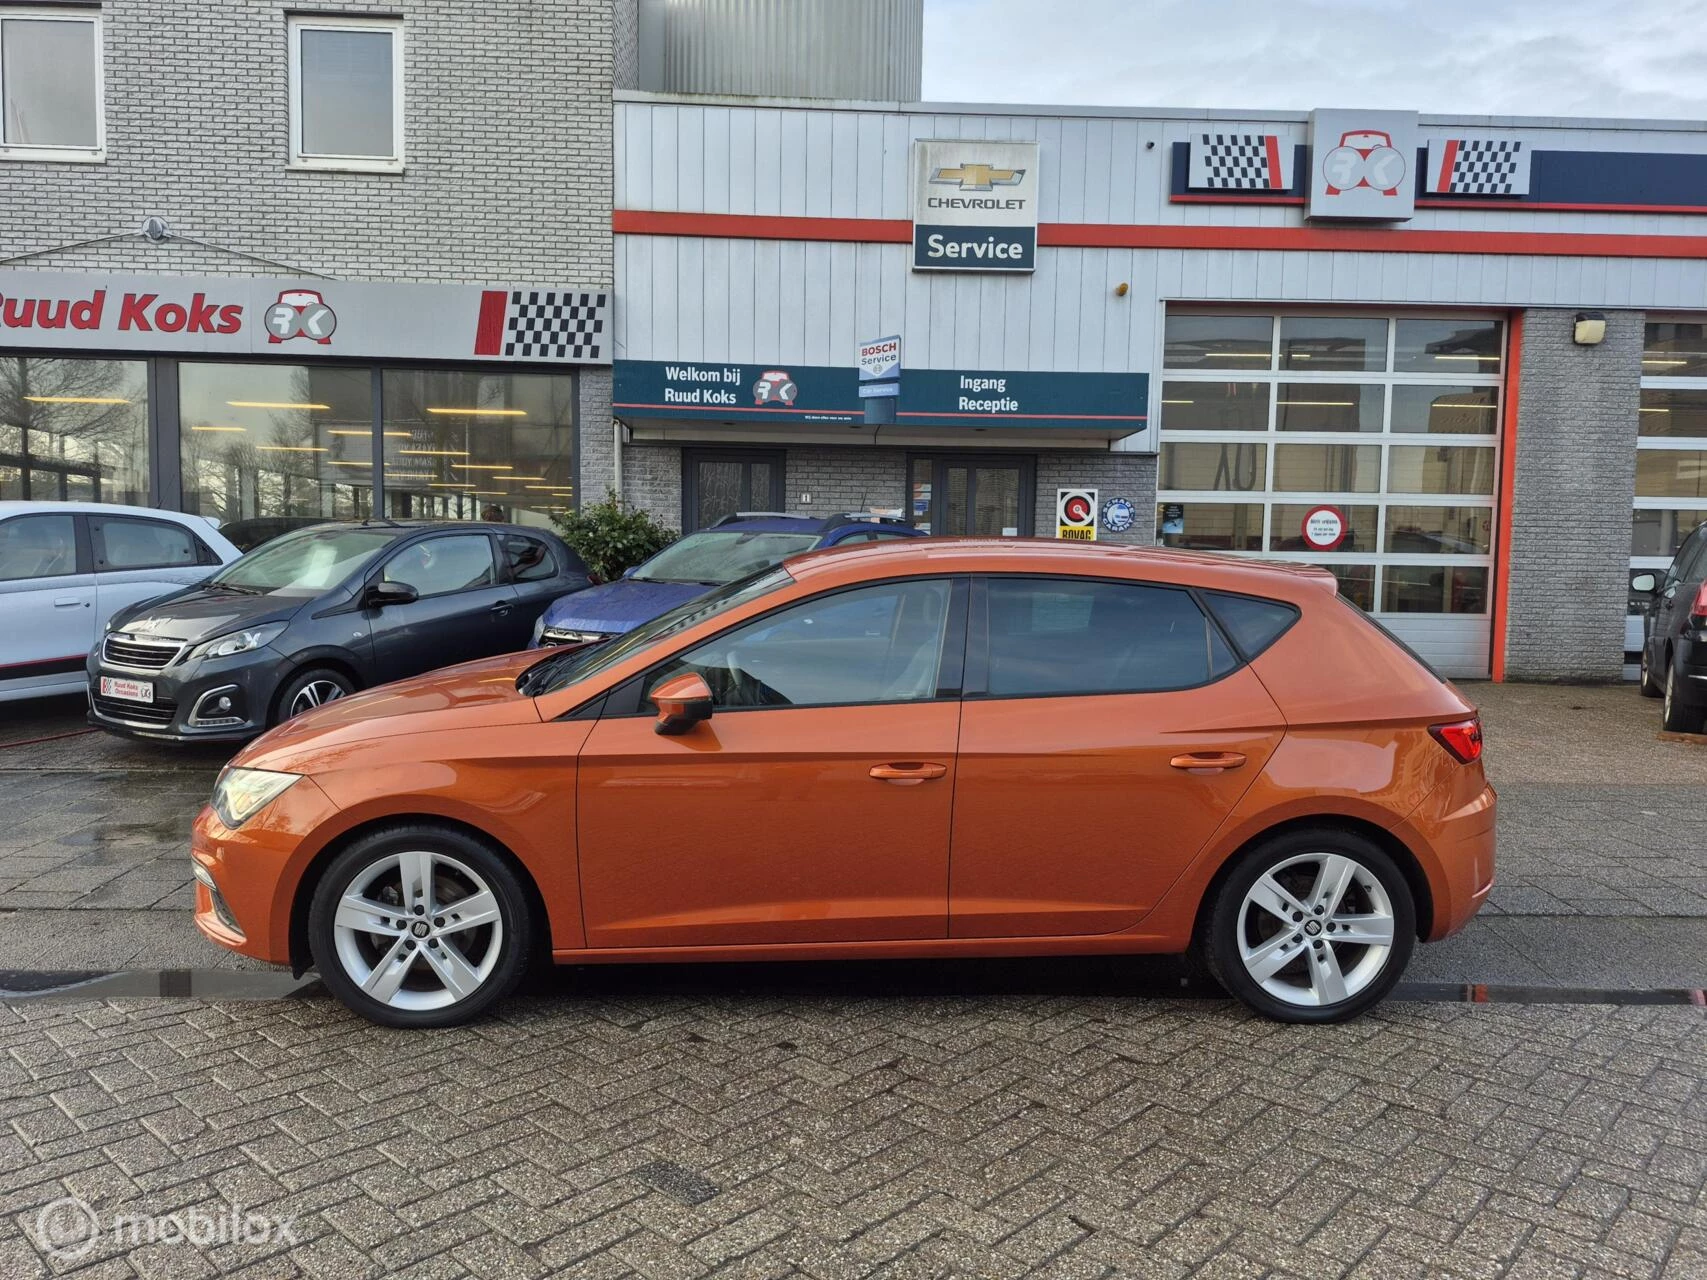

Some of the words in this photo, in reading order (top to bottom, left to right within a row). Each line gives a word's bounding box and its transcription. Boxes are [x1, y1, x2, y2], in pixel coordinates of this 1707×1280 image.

[927, 197, 1027, 210] CHEVROLET
[927, 233, 1024, 260] Service
[0, 290, 106, 330] uud
[117, 292, 244, 334] Koks
[861, 341, 897, 357] BOSCH
[861, 354, 897, 366] Service
[665, 366, 721, 382] Welkom
[723, 367, 741, 386] bij
[960, 375, 1007, 393] Ingang
[664, 387, 700, 403] Ruud
[703, 389, 737, 404] Koks
[959, 396, 1019, 414] Receptie
